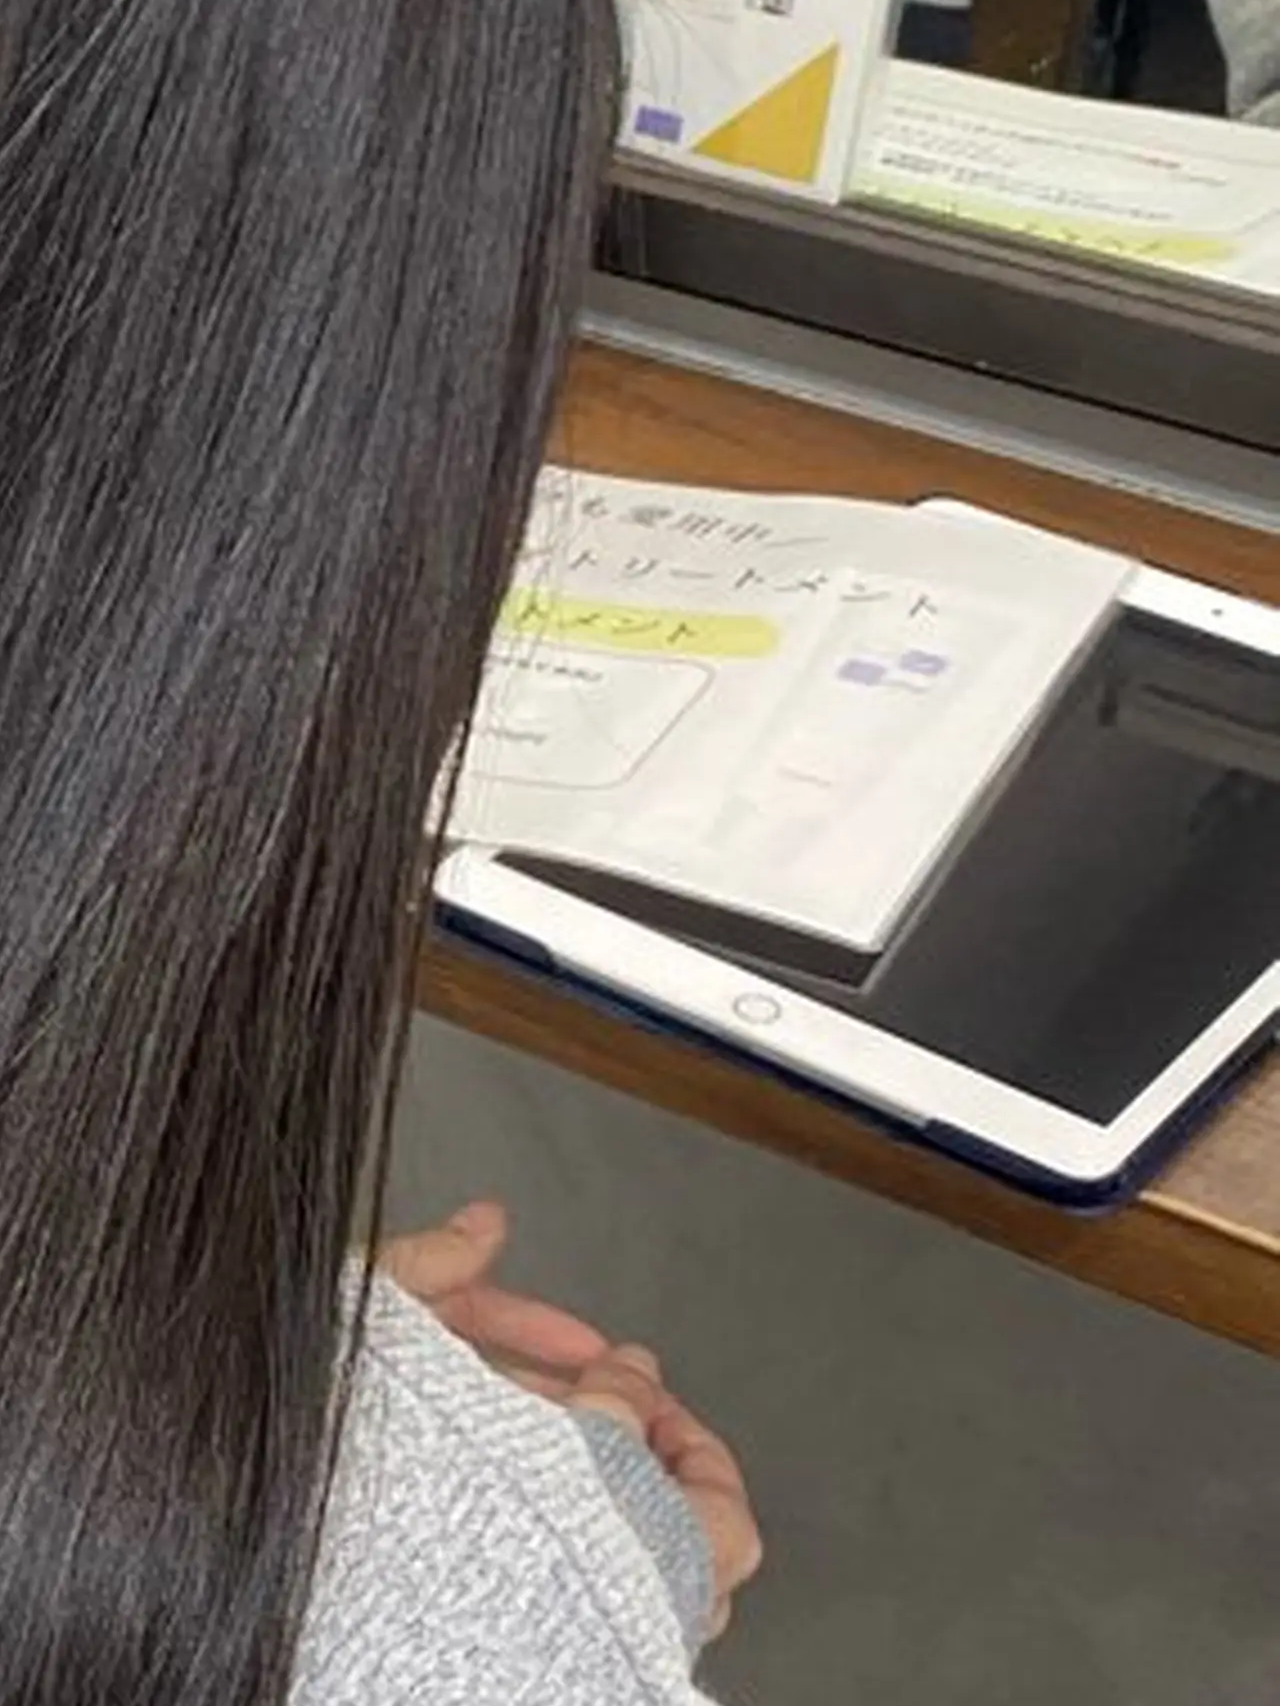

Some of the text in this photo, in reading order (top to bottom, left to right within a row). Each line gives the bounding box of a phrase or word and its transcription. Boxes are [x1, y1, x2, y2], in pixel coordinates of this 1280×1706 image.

[568, 548, 939, 619] トリートメント
